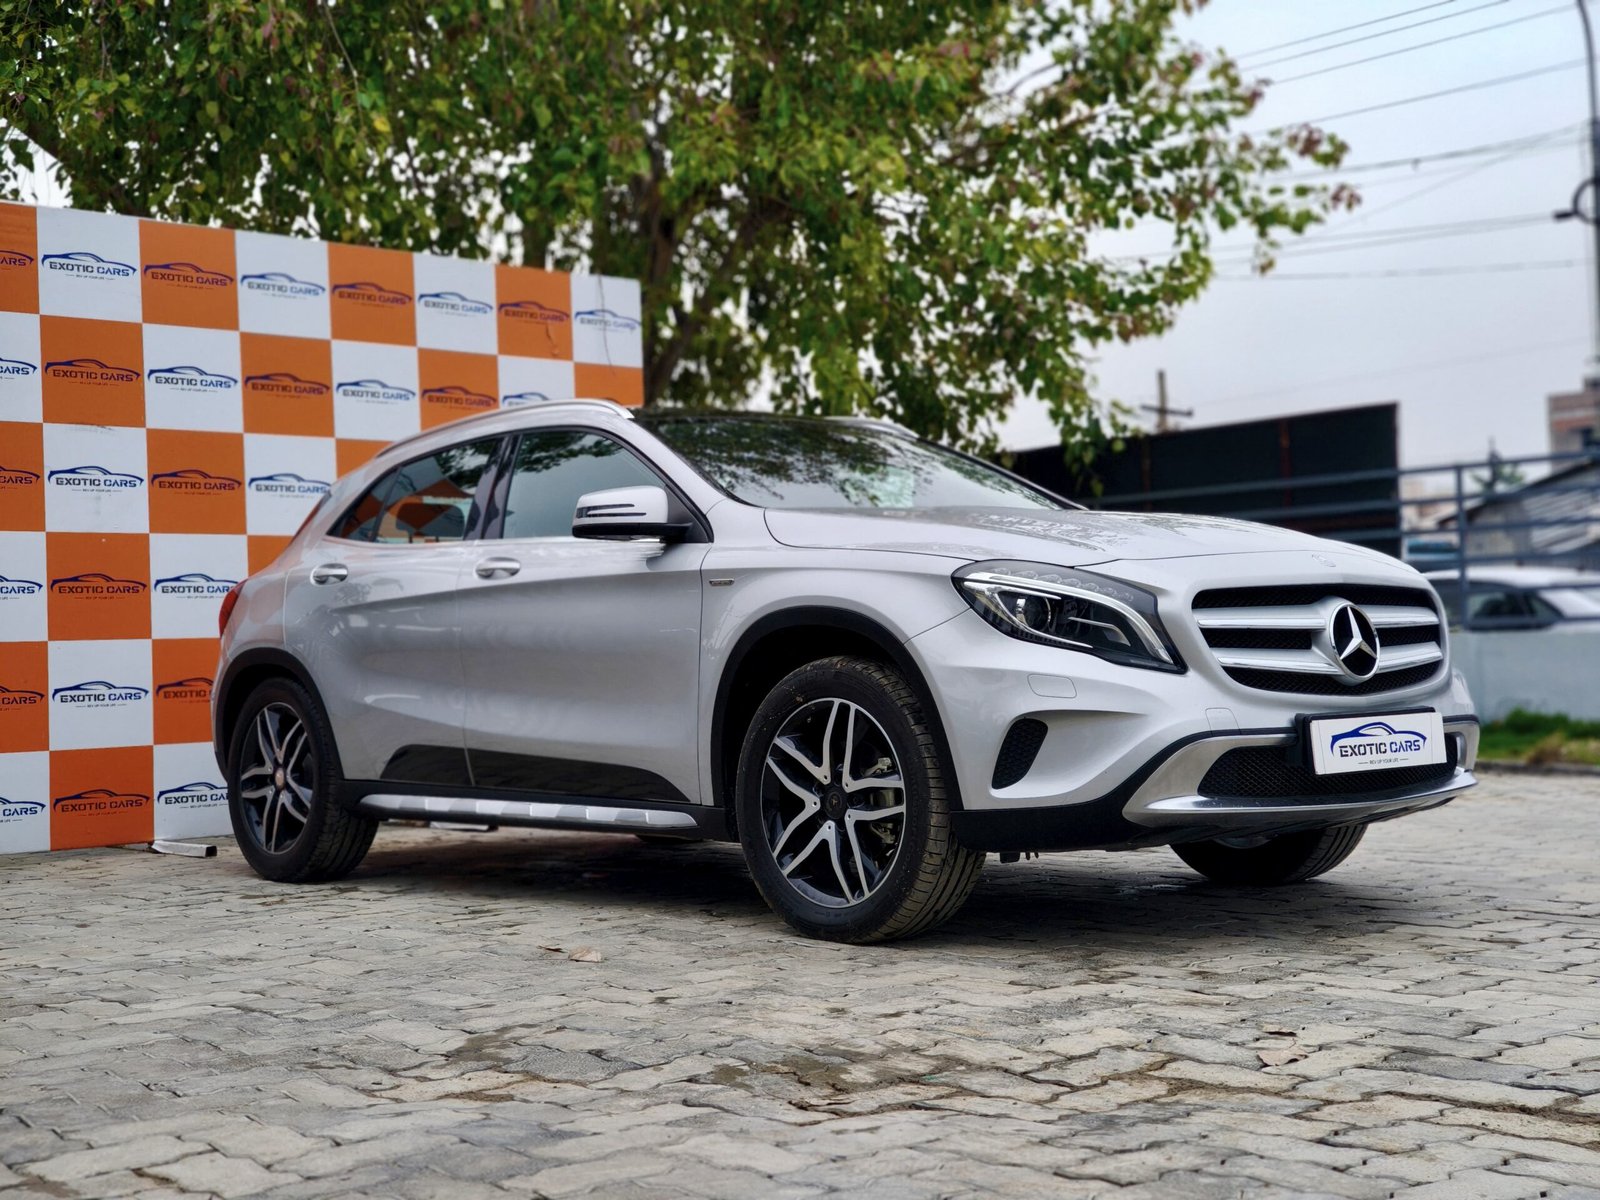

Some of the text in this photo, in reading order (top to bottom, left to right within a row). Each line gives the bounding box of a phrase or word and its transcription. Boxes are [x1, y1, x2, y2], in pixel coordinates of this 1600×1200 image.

[0, 256, 26, 266] ARS
[49, 261, 94, 273] EXOTIC
[96, 266, 130, 277] CARS
[151, 271, 194, 283] EXOTIC
[196, 276, 228, 287] CARS
[247, 281, 320, 296] EXOTIC CARS
[338, 290, 407, 305] EXOTIC CARS
[424, 300, 488, 314] EXOTIC CARS
[504, 308, 565, 322] EXOTIC CARS
[53, 369, 134, 382] EXOTIC CARS
[155, 376, 231, 388] EXOTIC CARS
[252, 382, 324, 395] EXOTIC CARS
[342, 388, 410, 401] EXOTIC CARS
[428, 395, 492, 407] EXOTIC CARS
[0, 475, 33, 484] CARS
[55, 477, 137, 488] EXOTIC CARS
[158, 481, 236, 491] EXOTIC CARS
[255, 483, 328, 494] EXOTIC CARS
[0, 586, 35, 594] CARS
[58, 585, 140, 594] EXOTIC CARS
[161, 585, 232, 594] EXOTIC CAR
[60, 692, 142, 703] EXOTIC CARS
[163, 689, 207, 699] EXOTIC
[2, 696, 37, 705] CARS
[1338, 739, 1421, 758] EXOTIC CARS
[164, 793, 229, 805] EXOTIC CA
[2, 807, 38, 817] CARS
[61, 799, 143, 813] EXOTIC CARS
